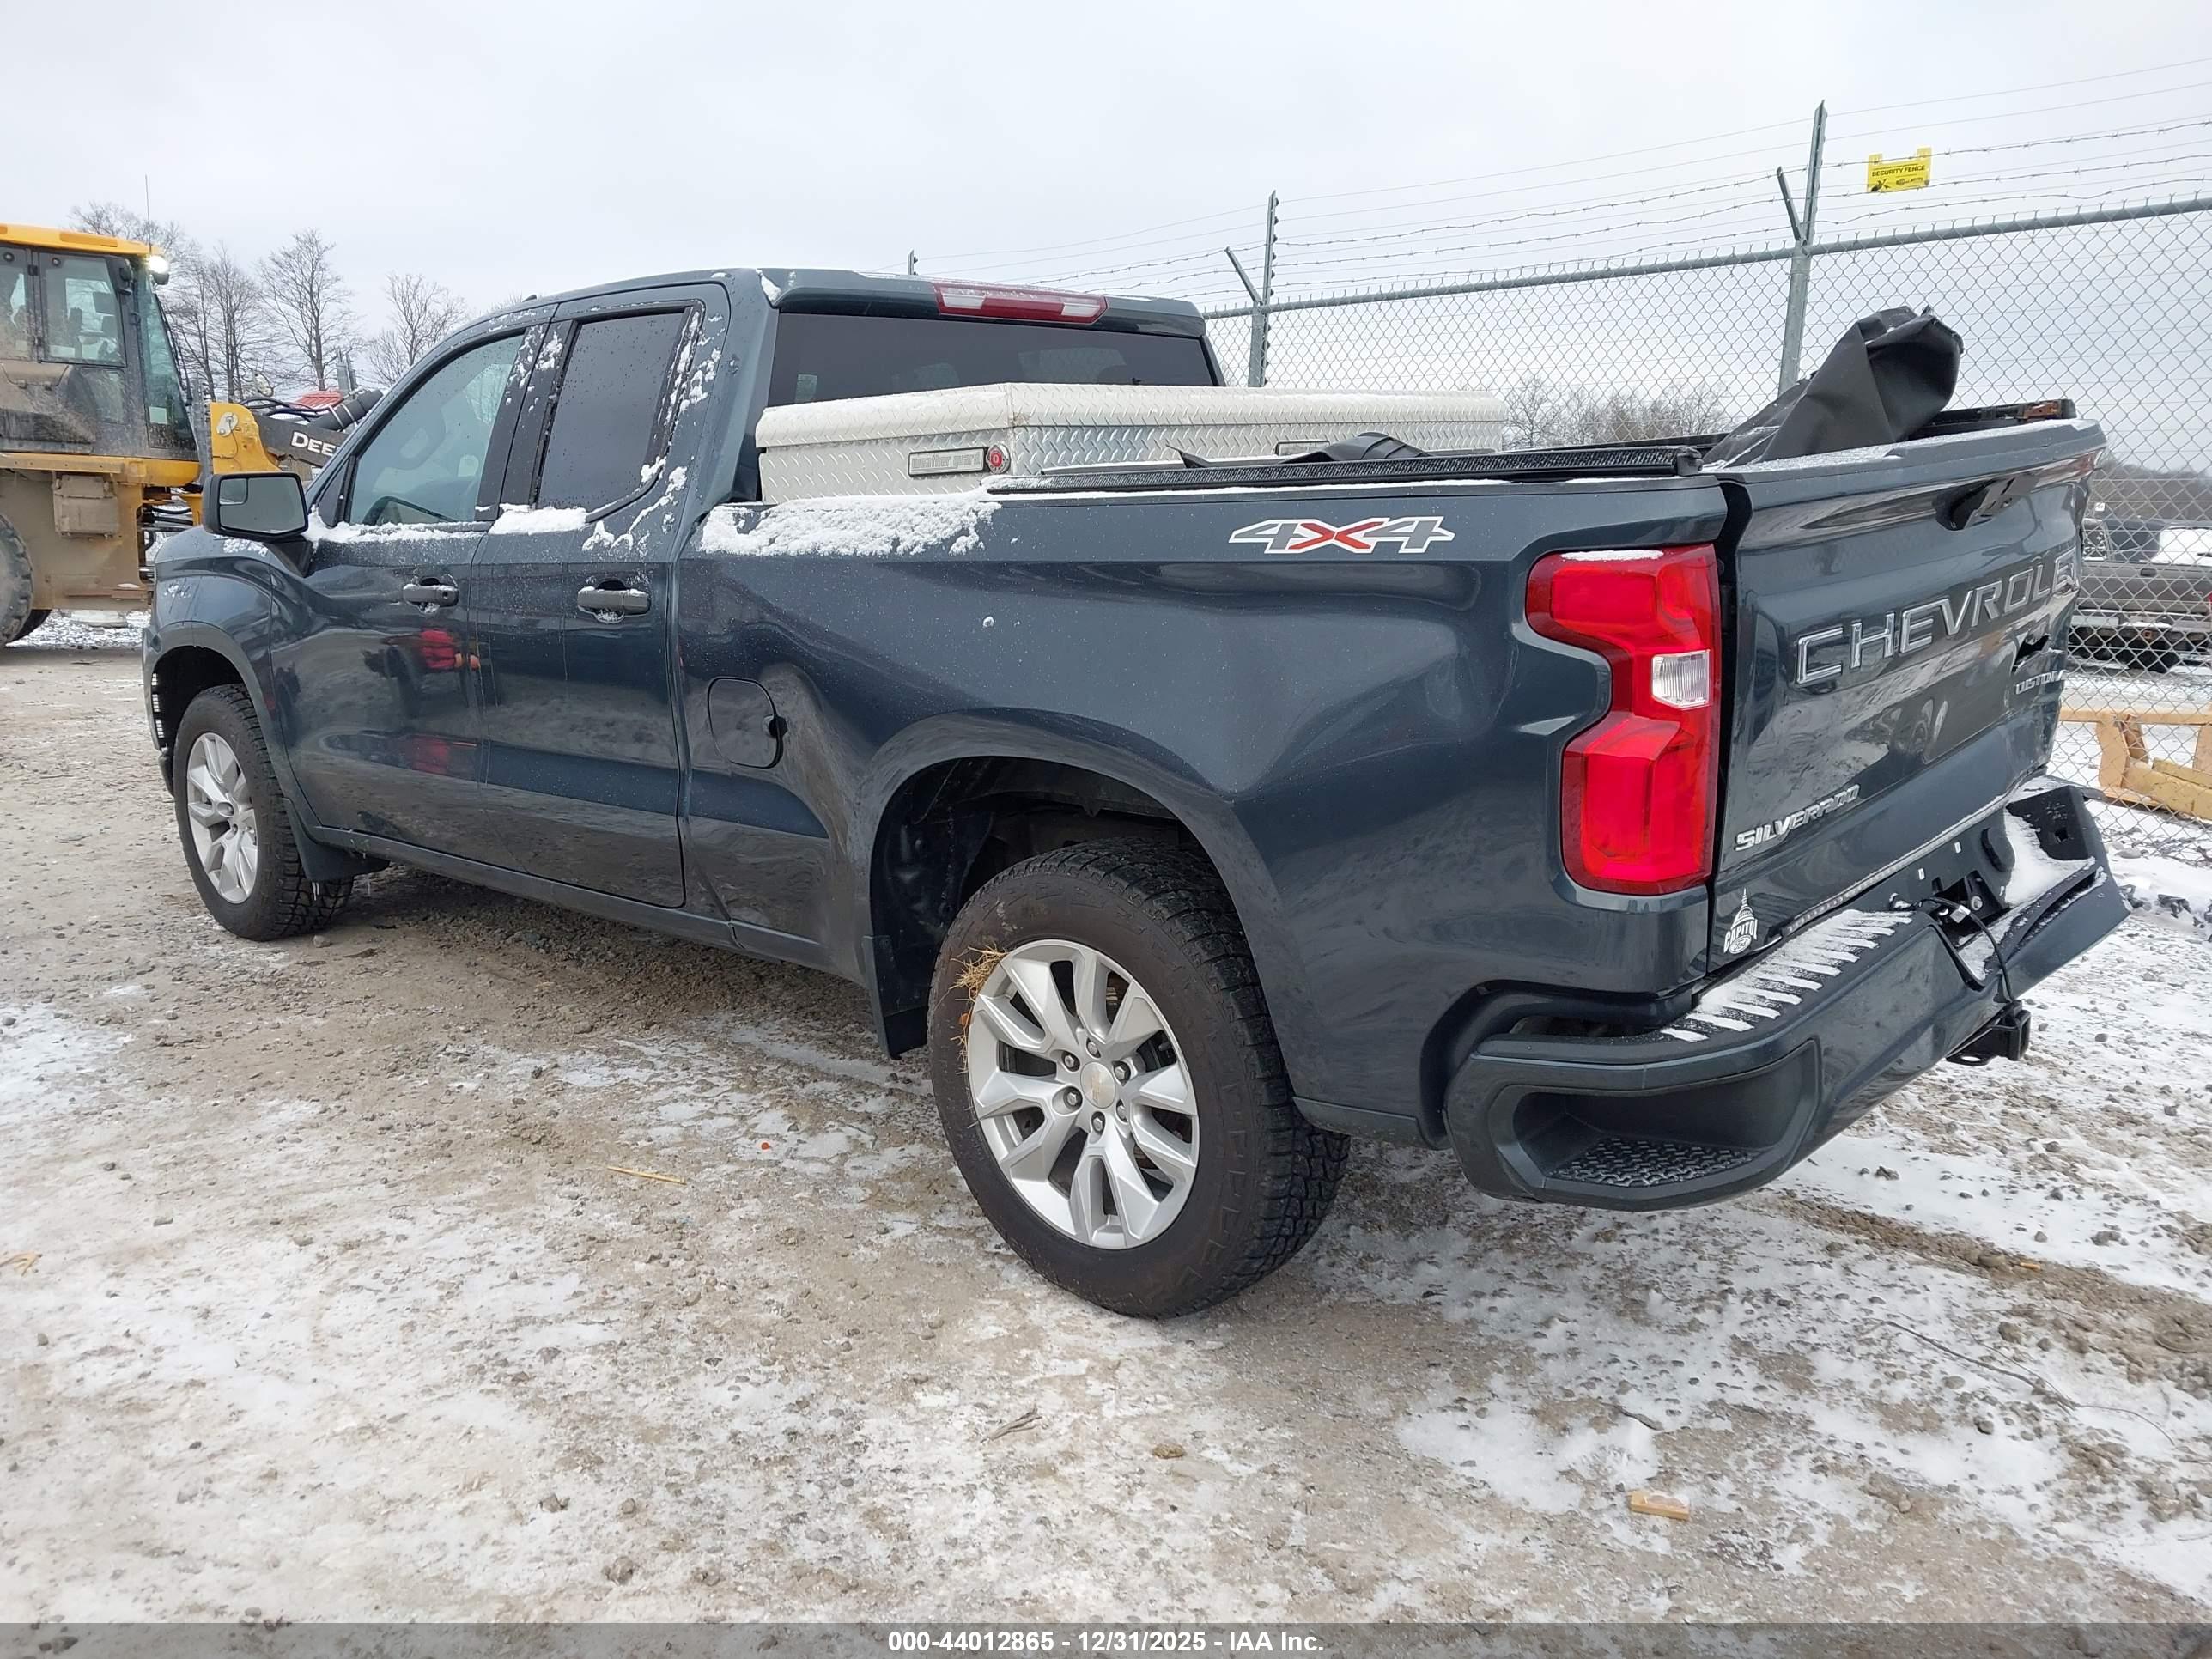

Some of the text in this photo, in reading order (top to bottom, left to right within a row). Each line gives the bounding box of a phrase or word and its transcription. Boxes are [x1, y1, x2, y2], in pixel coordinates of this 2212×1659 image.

[1872, 167, 1904, 177] SECURITY
[1905, 164, 1925, 173] FENCE
[291, 430, 340, 457] DEE
[1796, 545, 2077, 685] CHEVROLE
[1734, 783, 1861, 852] SILVERADO
[1723, 918, 1758, 953] CAPITOL
